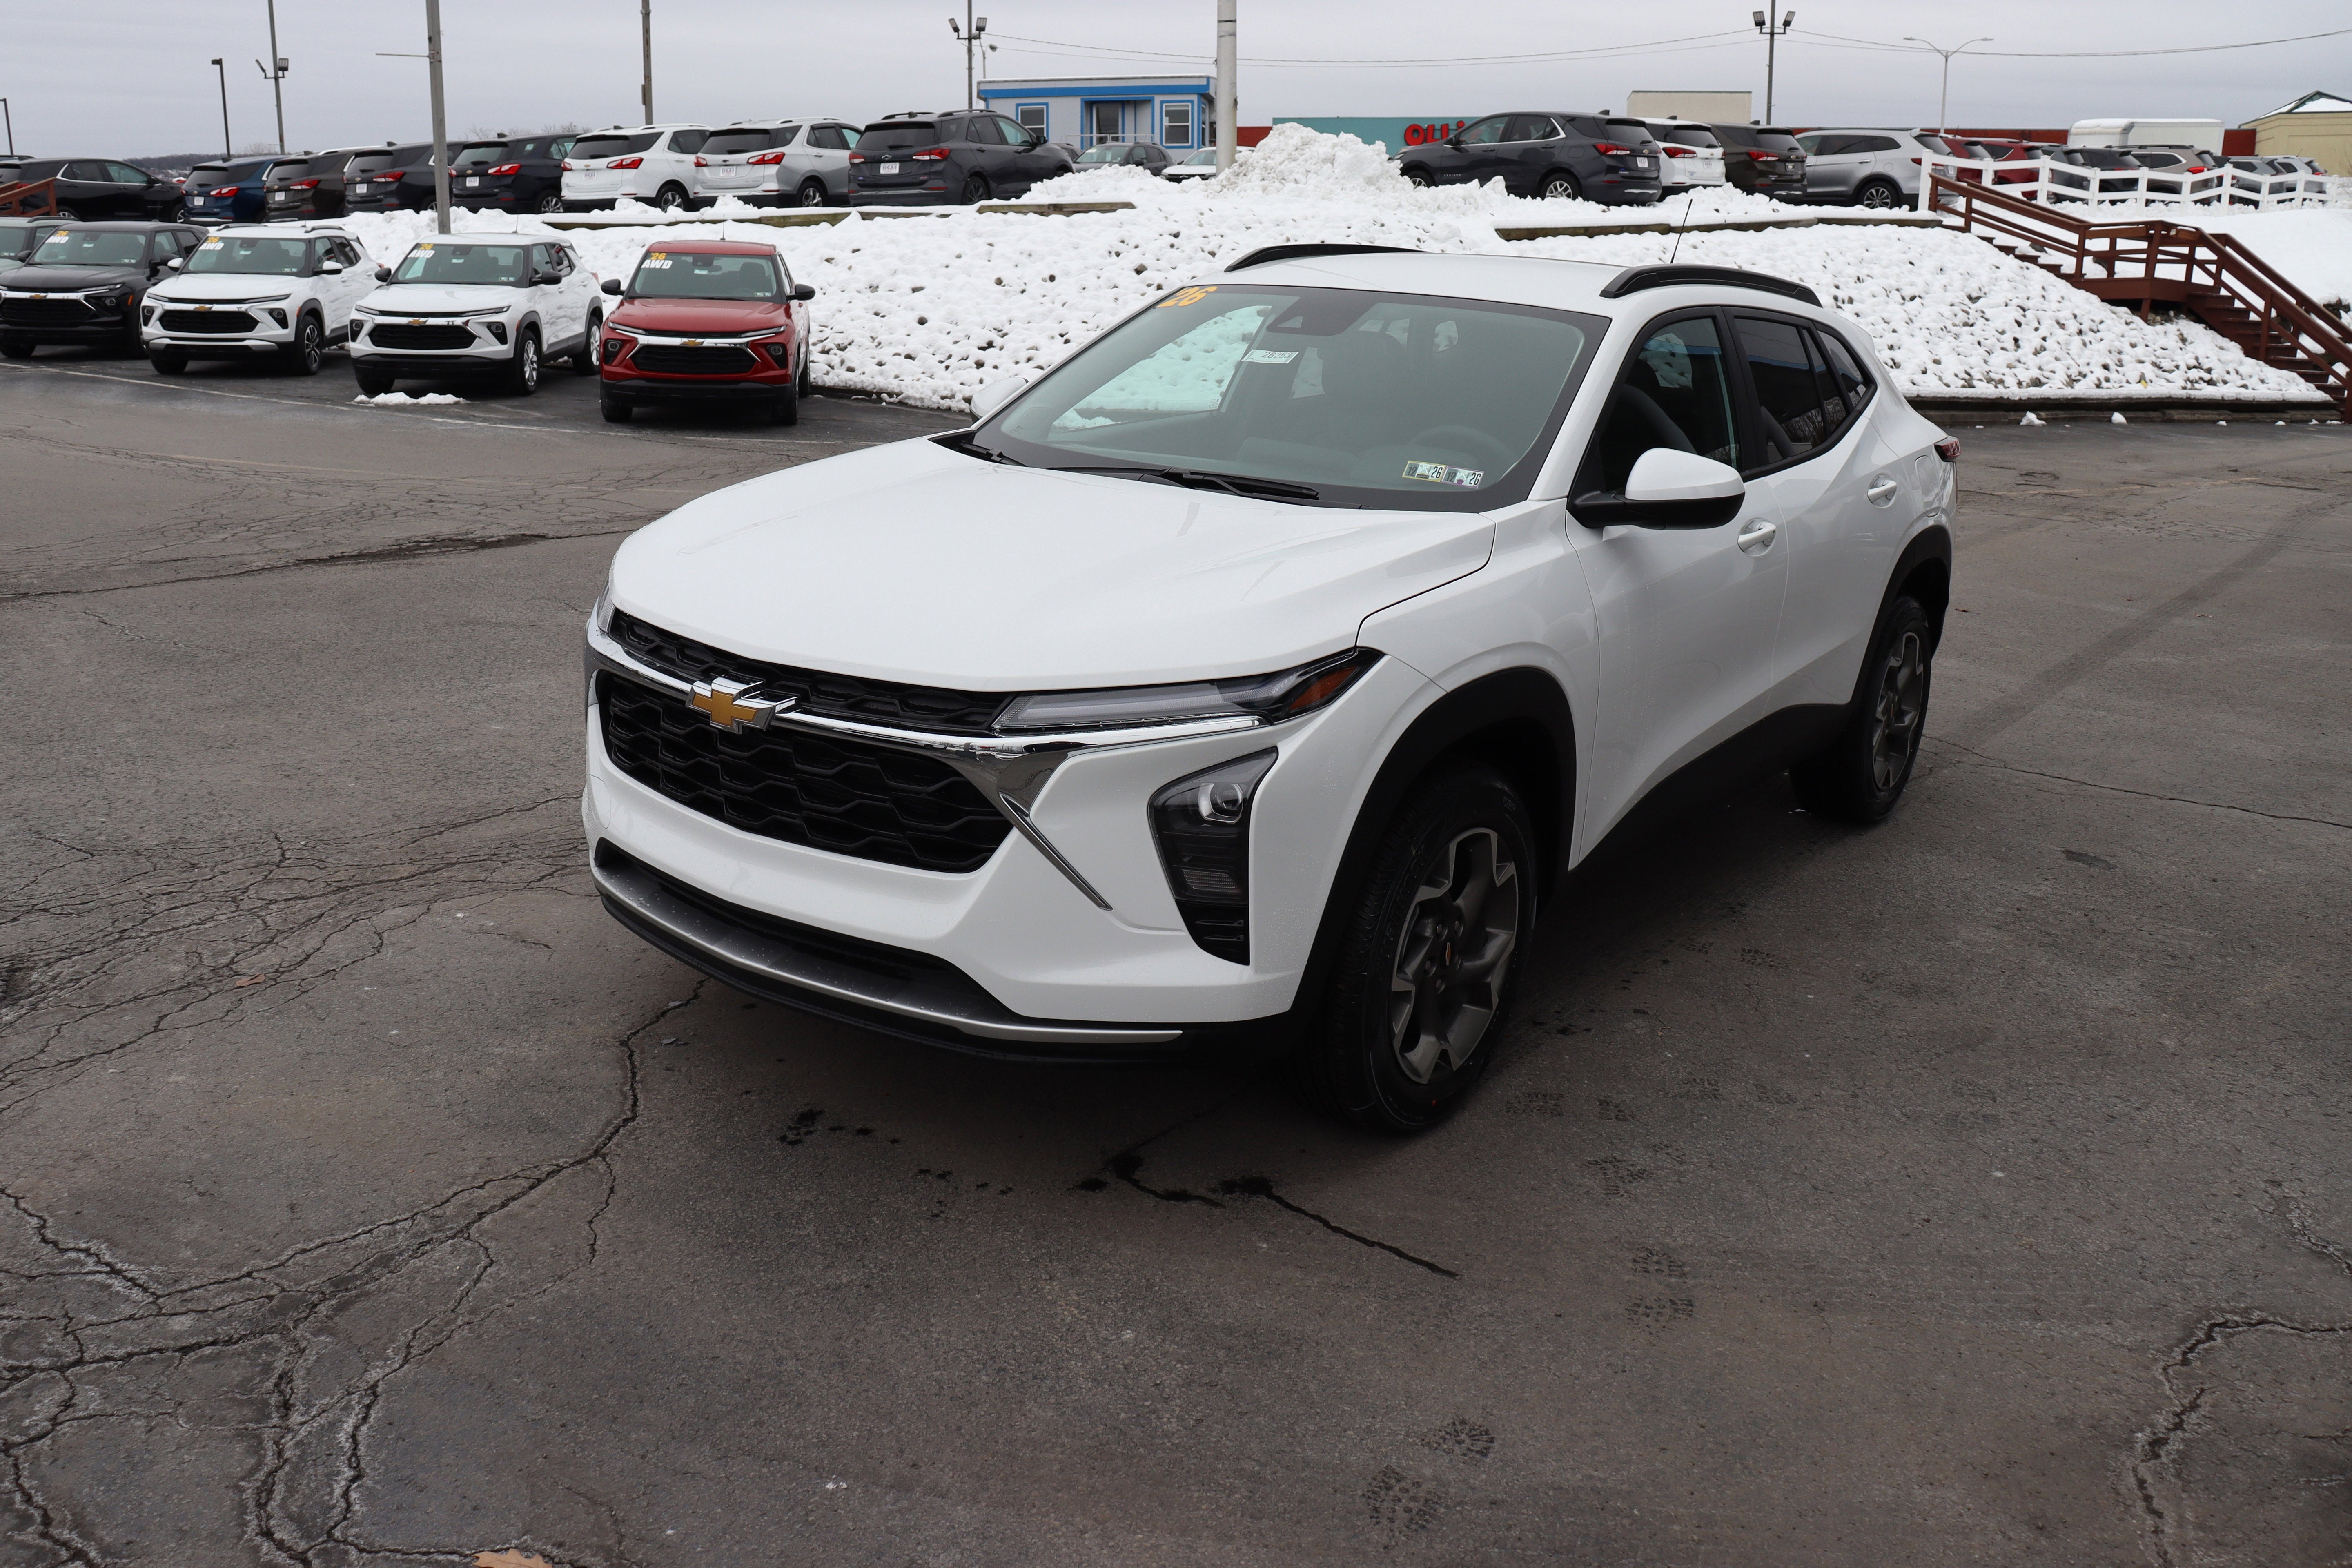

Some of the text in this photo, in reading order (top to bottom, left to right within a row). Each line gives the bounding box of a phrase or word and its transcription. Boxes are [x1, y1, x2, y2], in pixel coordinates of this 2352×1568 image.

[408, 249, 435, 258] AWD
[641, 259, 673, 269] AWD
[1408, 466, 1443, 479] 12 26
[1446, 471, 1481, 485] 12 26
